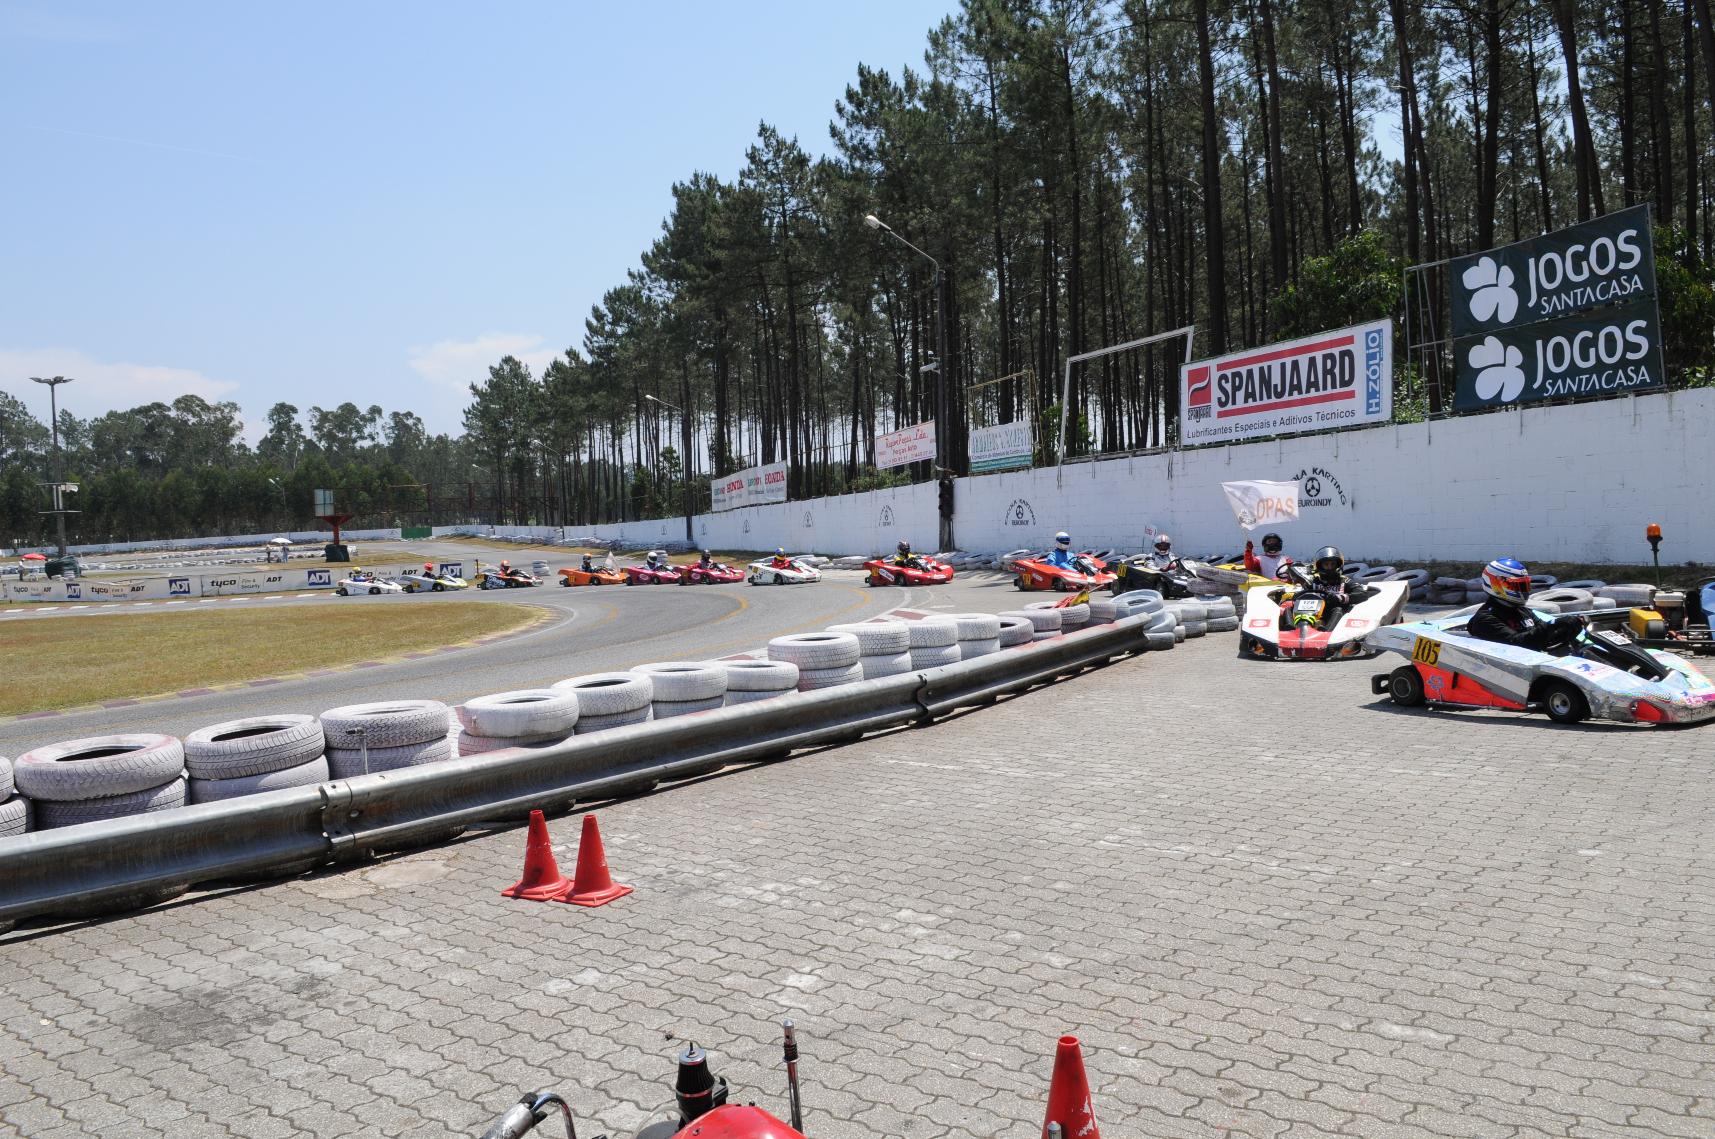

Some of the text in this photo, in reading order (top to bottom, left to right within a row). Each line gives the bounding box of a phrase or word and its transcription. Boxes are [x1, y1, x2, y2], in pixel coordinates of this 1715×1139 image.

[1528, 229, 1641, 307] JOGOS
[1533, 319, 1649, 390] JOGOS
[1217, 349, 1355, 408] SPANJAARD
[1187, 426, 1233, 439] Lubrificantes
[1235, 420, 1271, 434] Especiais
[1279, 414, 1313, 427] Aditivos
[1315, 409, 1356, 421] Técnicos
[1312, 467, 1347, 505] KARTING
[1298, 498, 1332, 507] EUROINDY
[91, 586, 108, 594] tyco
[169, 581, 190, 592] ADT
[209, 579, 237, 588] tyco
[308, 572, 331, 584] ADT
[1414, 638, 1441, 665] 105
